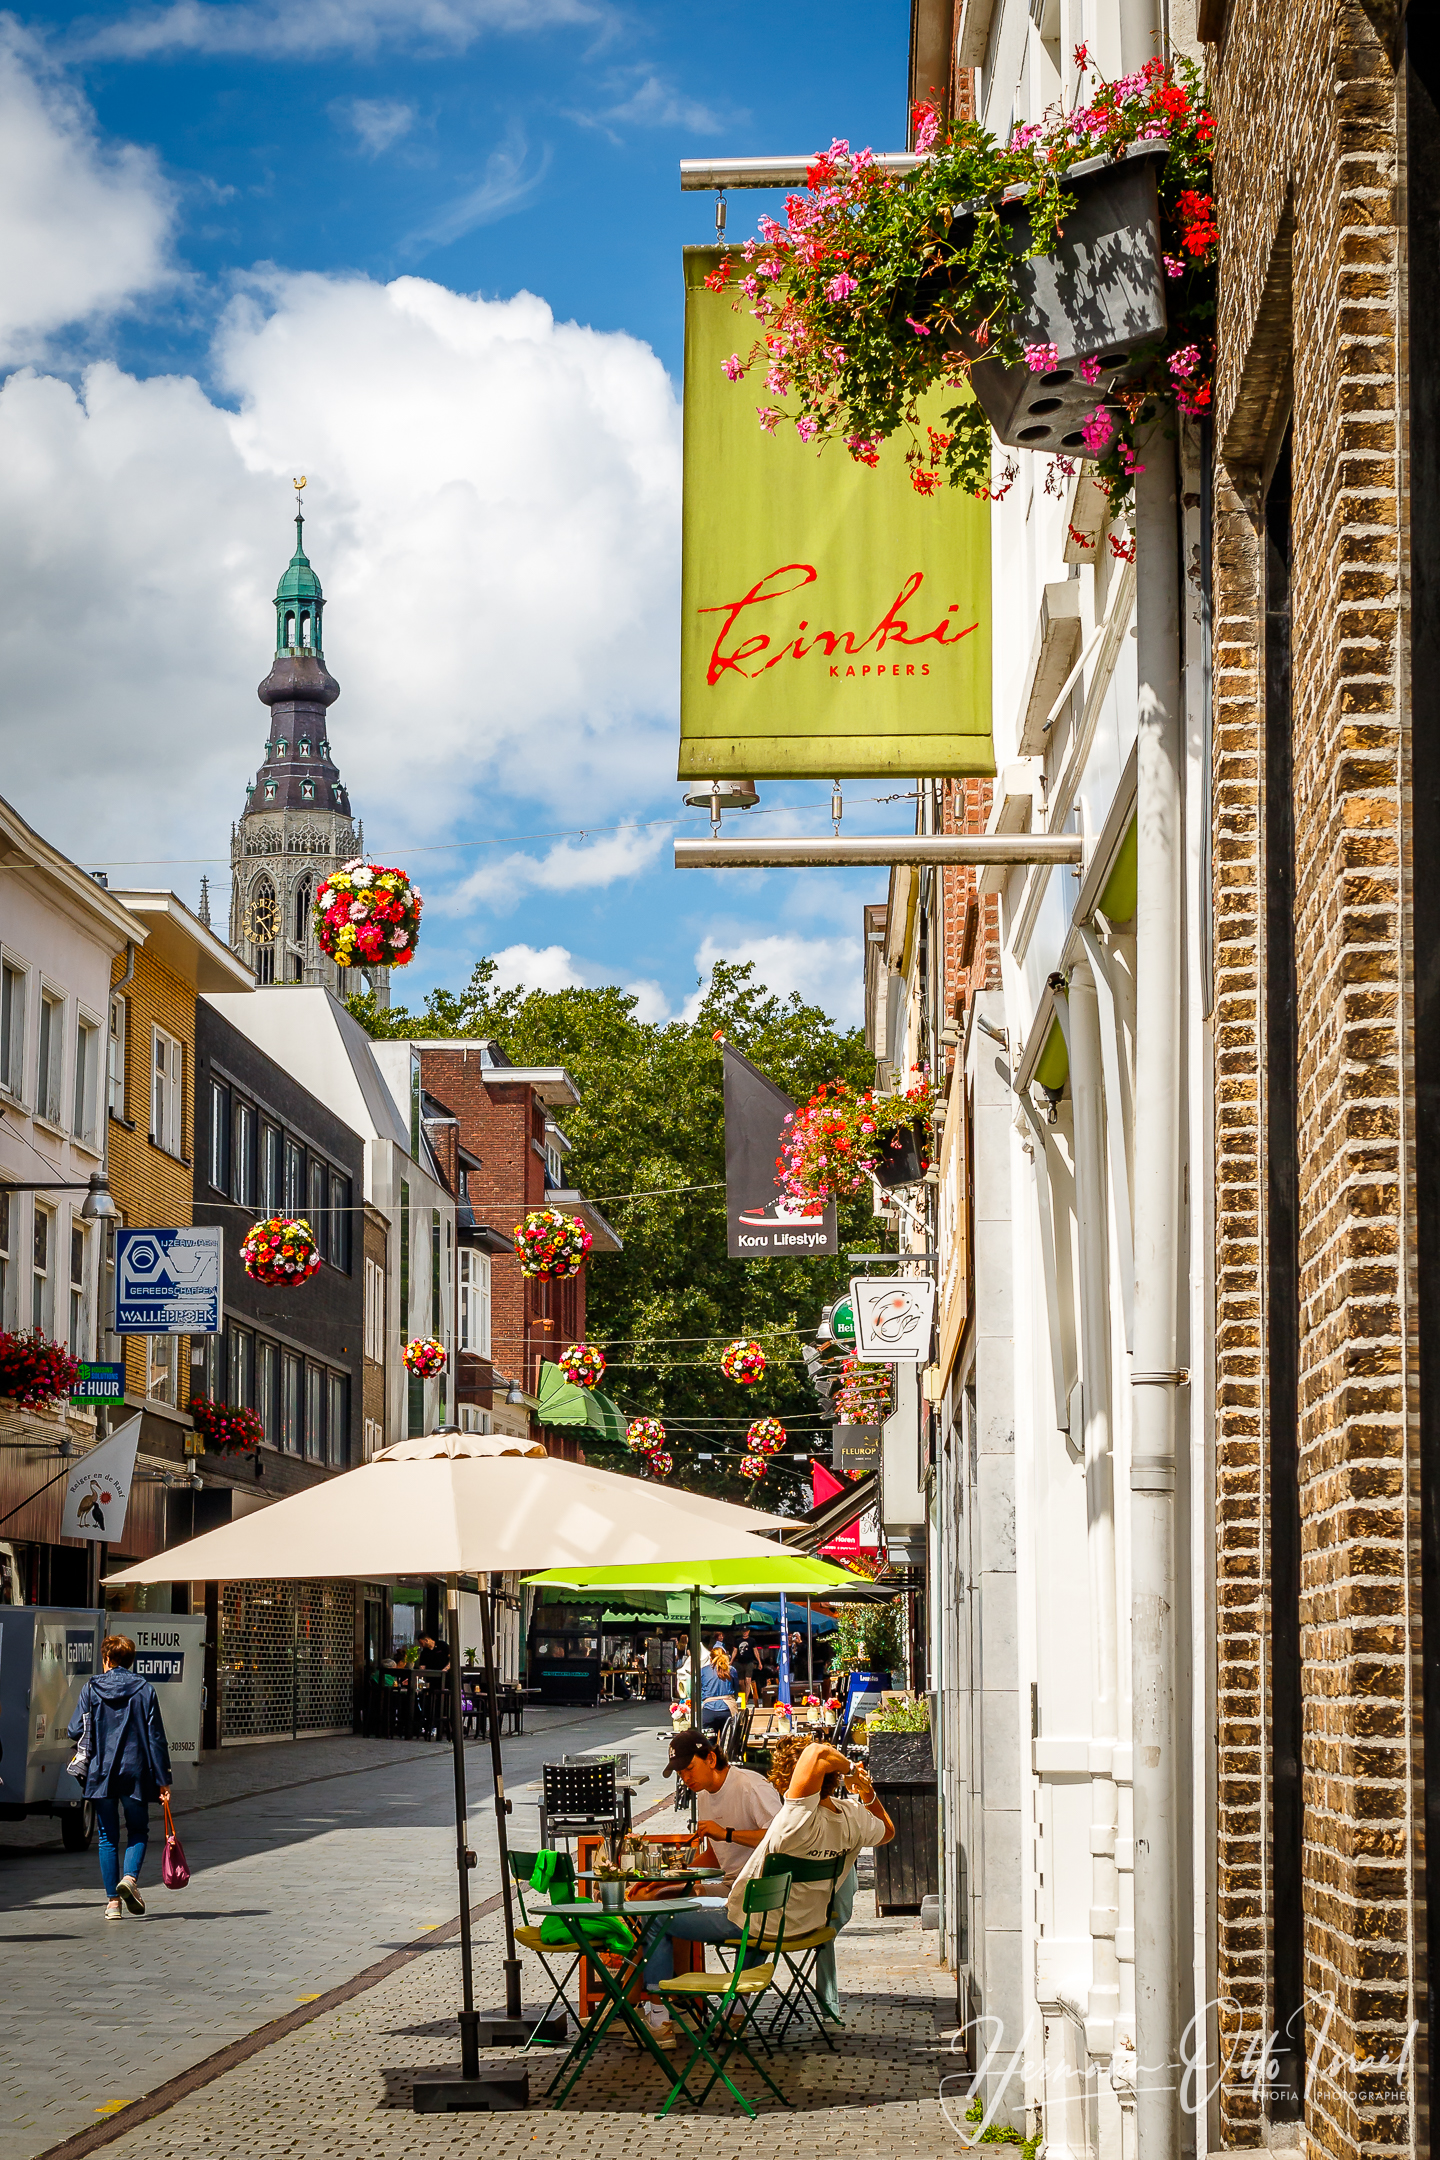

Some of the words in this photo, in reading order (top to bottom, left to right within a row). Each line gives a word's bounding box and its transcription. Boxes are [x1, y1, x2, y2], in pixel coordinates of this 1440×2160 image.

[698, 564, 979, 686] Kinki
[829, 663, 931, 677] KAPPERS
[737, 1234, 768, 1247] Koru
[773, 1232, 828, 1248] Lifestyle
[837, 1323, 855, 1333] Hei
[87, 1381, 119, 1396] HUUR
[841, 1447, 876, 1455] FLEUROP
[70, 1473, 91, 1493] Reiger
[104, 1473, 113, 1482] de
[113, 1480, 126, 1498] Raaf
[137, 1631, 149, 1646] TE
[151, 1632, 180, 1647] HUUR
